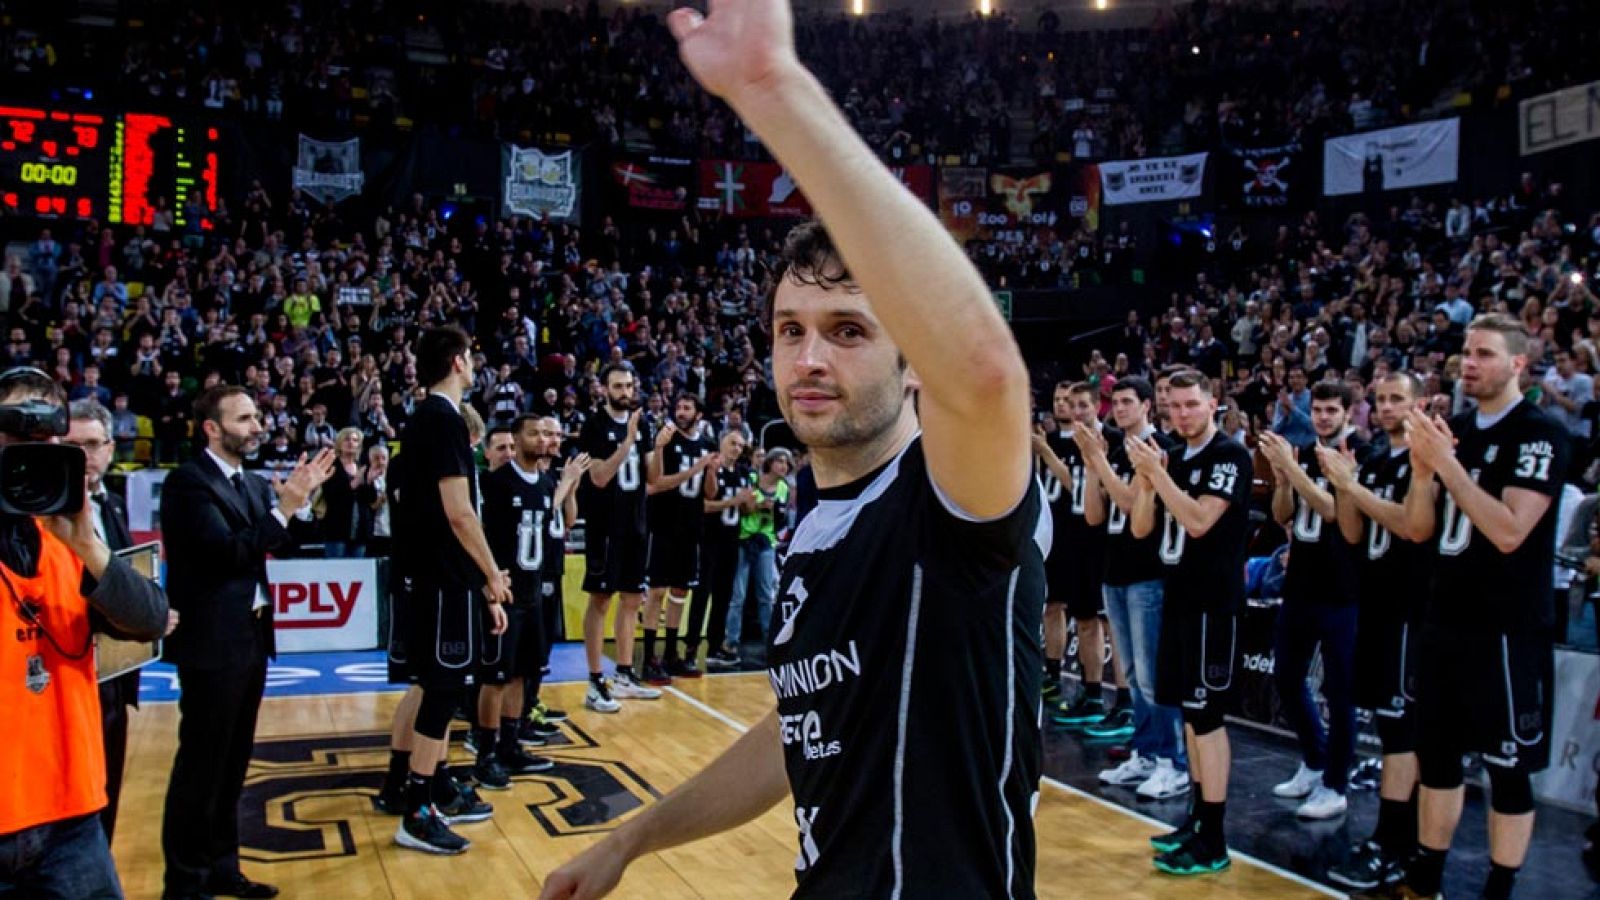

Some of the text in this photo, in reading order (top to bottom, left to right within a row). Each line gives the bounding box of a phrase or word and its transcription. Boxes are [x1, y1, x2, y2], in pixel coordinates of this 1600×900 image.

[21, 162, 77, 186] 00:00
[1515, 455, 1551, 481] 31
[1208, 473, 1236, 495] 31
